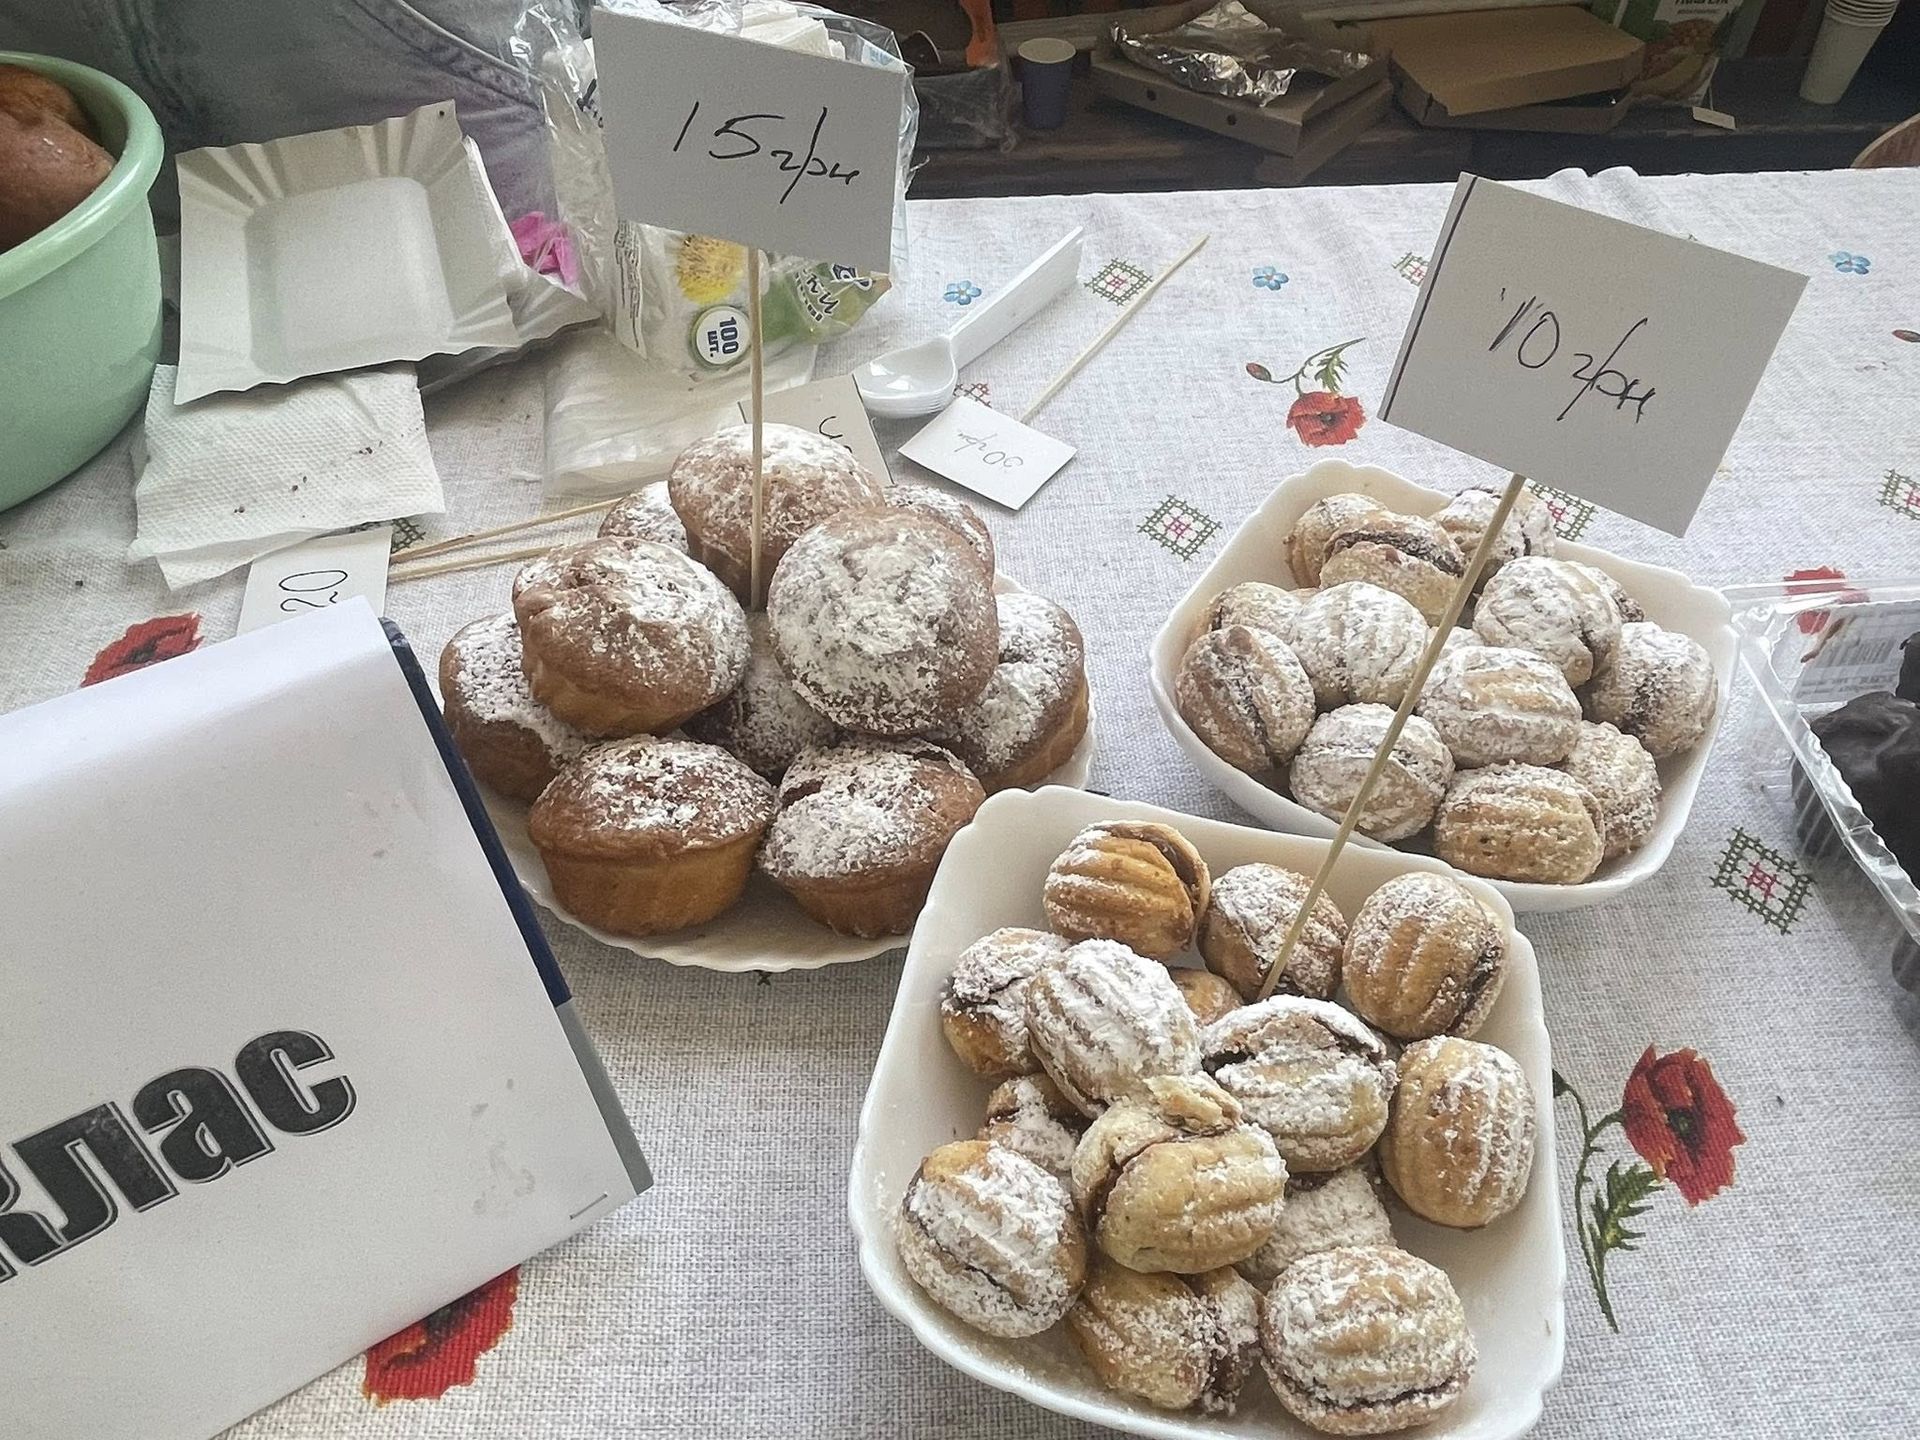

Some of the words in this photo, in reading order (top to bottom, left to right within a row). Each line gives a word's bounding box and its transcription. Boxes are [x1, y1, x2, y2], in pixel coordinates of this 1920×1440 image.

[673, 101, 785, 160] 15
[706, 330, 720, 358] шт.
[718, 316, 740, 355] 100
[1489, 287, 1561, 369] 10
